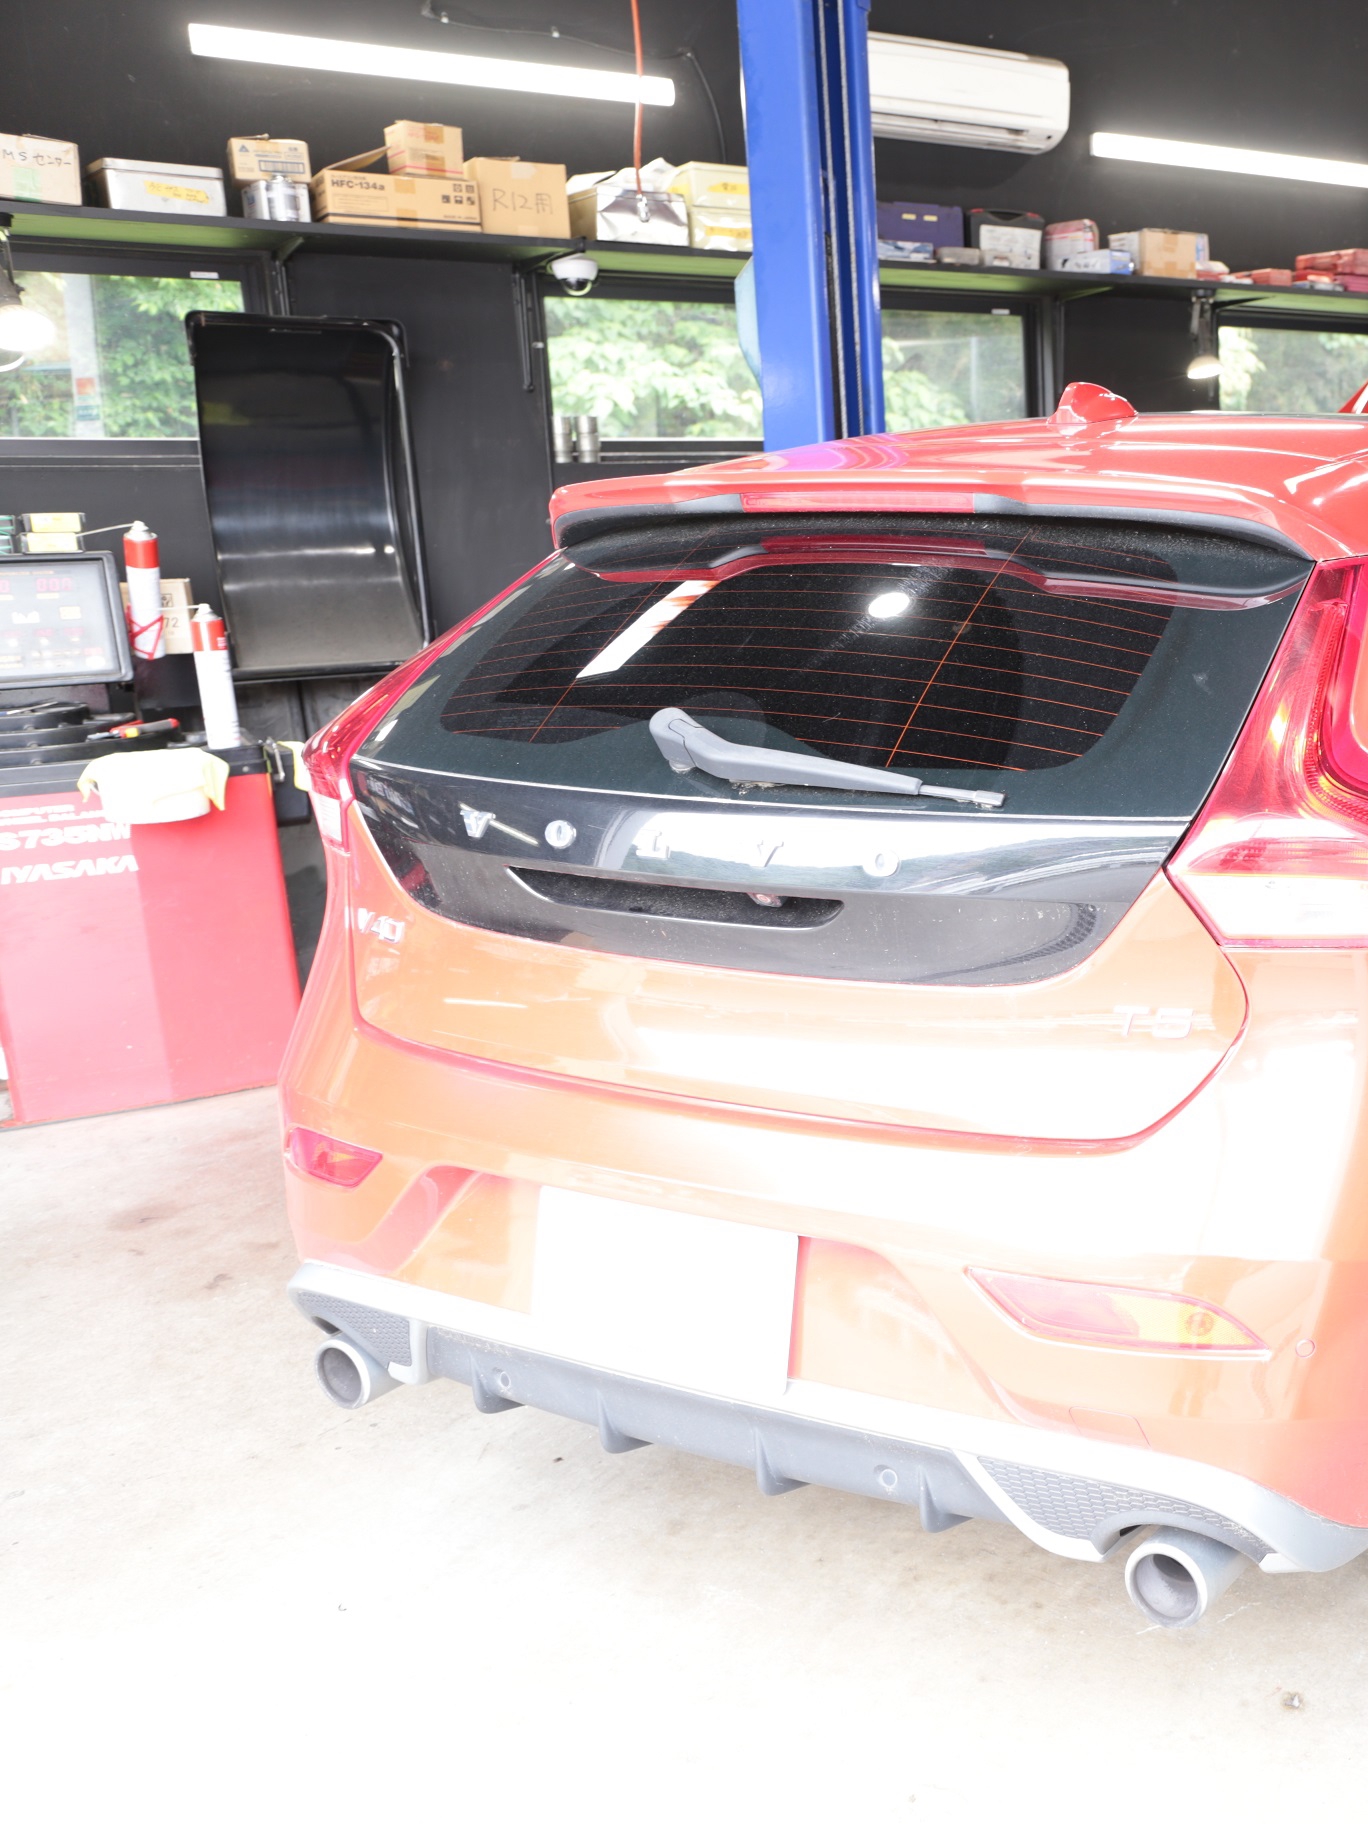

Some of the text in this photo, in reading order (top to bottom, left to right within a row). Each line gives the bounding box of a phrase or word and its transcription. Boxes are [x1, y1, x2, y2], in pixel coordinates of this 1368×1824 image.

[331, 179, 385, 191] HFC-134a
[0, 854, 139, 885] IYASAKA
[357, 907, 405, 944] V40
[1113, 1005, 1194, 1039] T5
